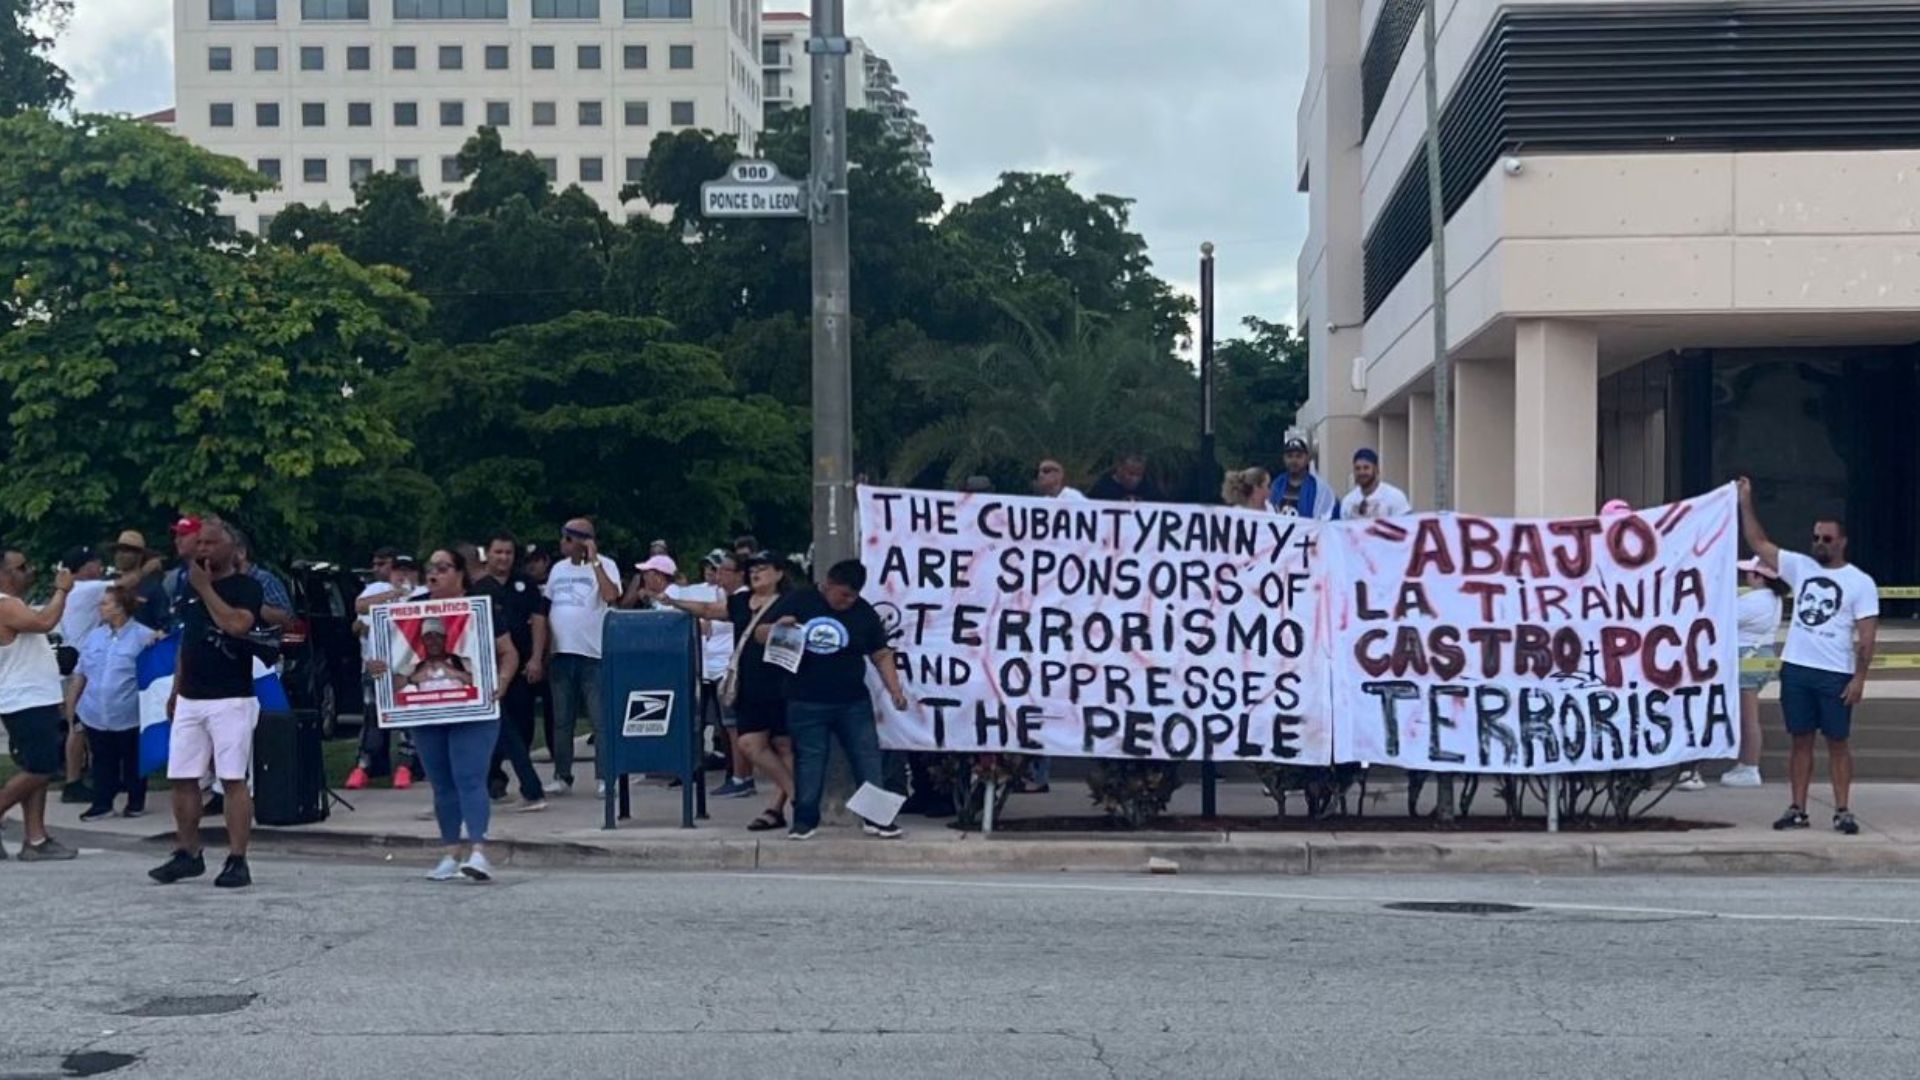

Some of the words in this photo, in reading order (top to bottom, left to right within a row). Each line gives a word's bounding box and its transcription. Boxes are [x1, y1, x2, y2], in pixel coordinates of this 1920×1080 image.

[709, 193, 748, 209] PONCE
[769, 193, 799, 209] LEON
[738, 166, 768, 179] 900
[872, 494, 958, 535] THE
[977, 501, 1098, 543] CUBAN
[1102, 508, 1295, 564] TYRANNY
[880, 546, 973, 588] ARE
[997, 547, 1243, 604] SPONSORS
[1259, 573, 1310, 609] OF
[1356, 580, 1437, 621] LA
[893, 652, 970, 686] AND
[1000, 657, 1301, 711] OPPRESSES
[1354, 624, 1583, 681] CASTRO
[1600, 618, 1718, 688] PCC
[919, 698, 1044, 750] THE
[1082, 705, 1301, 760] PEOPLE
